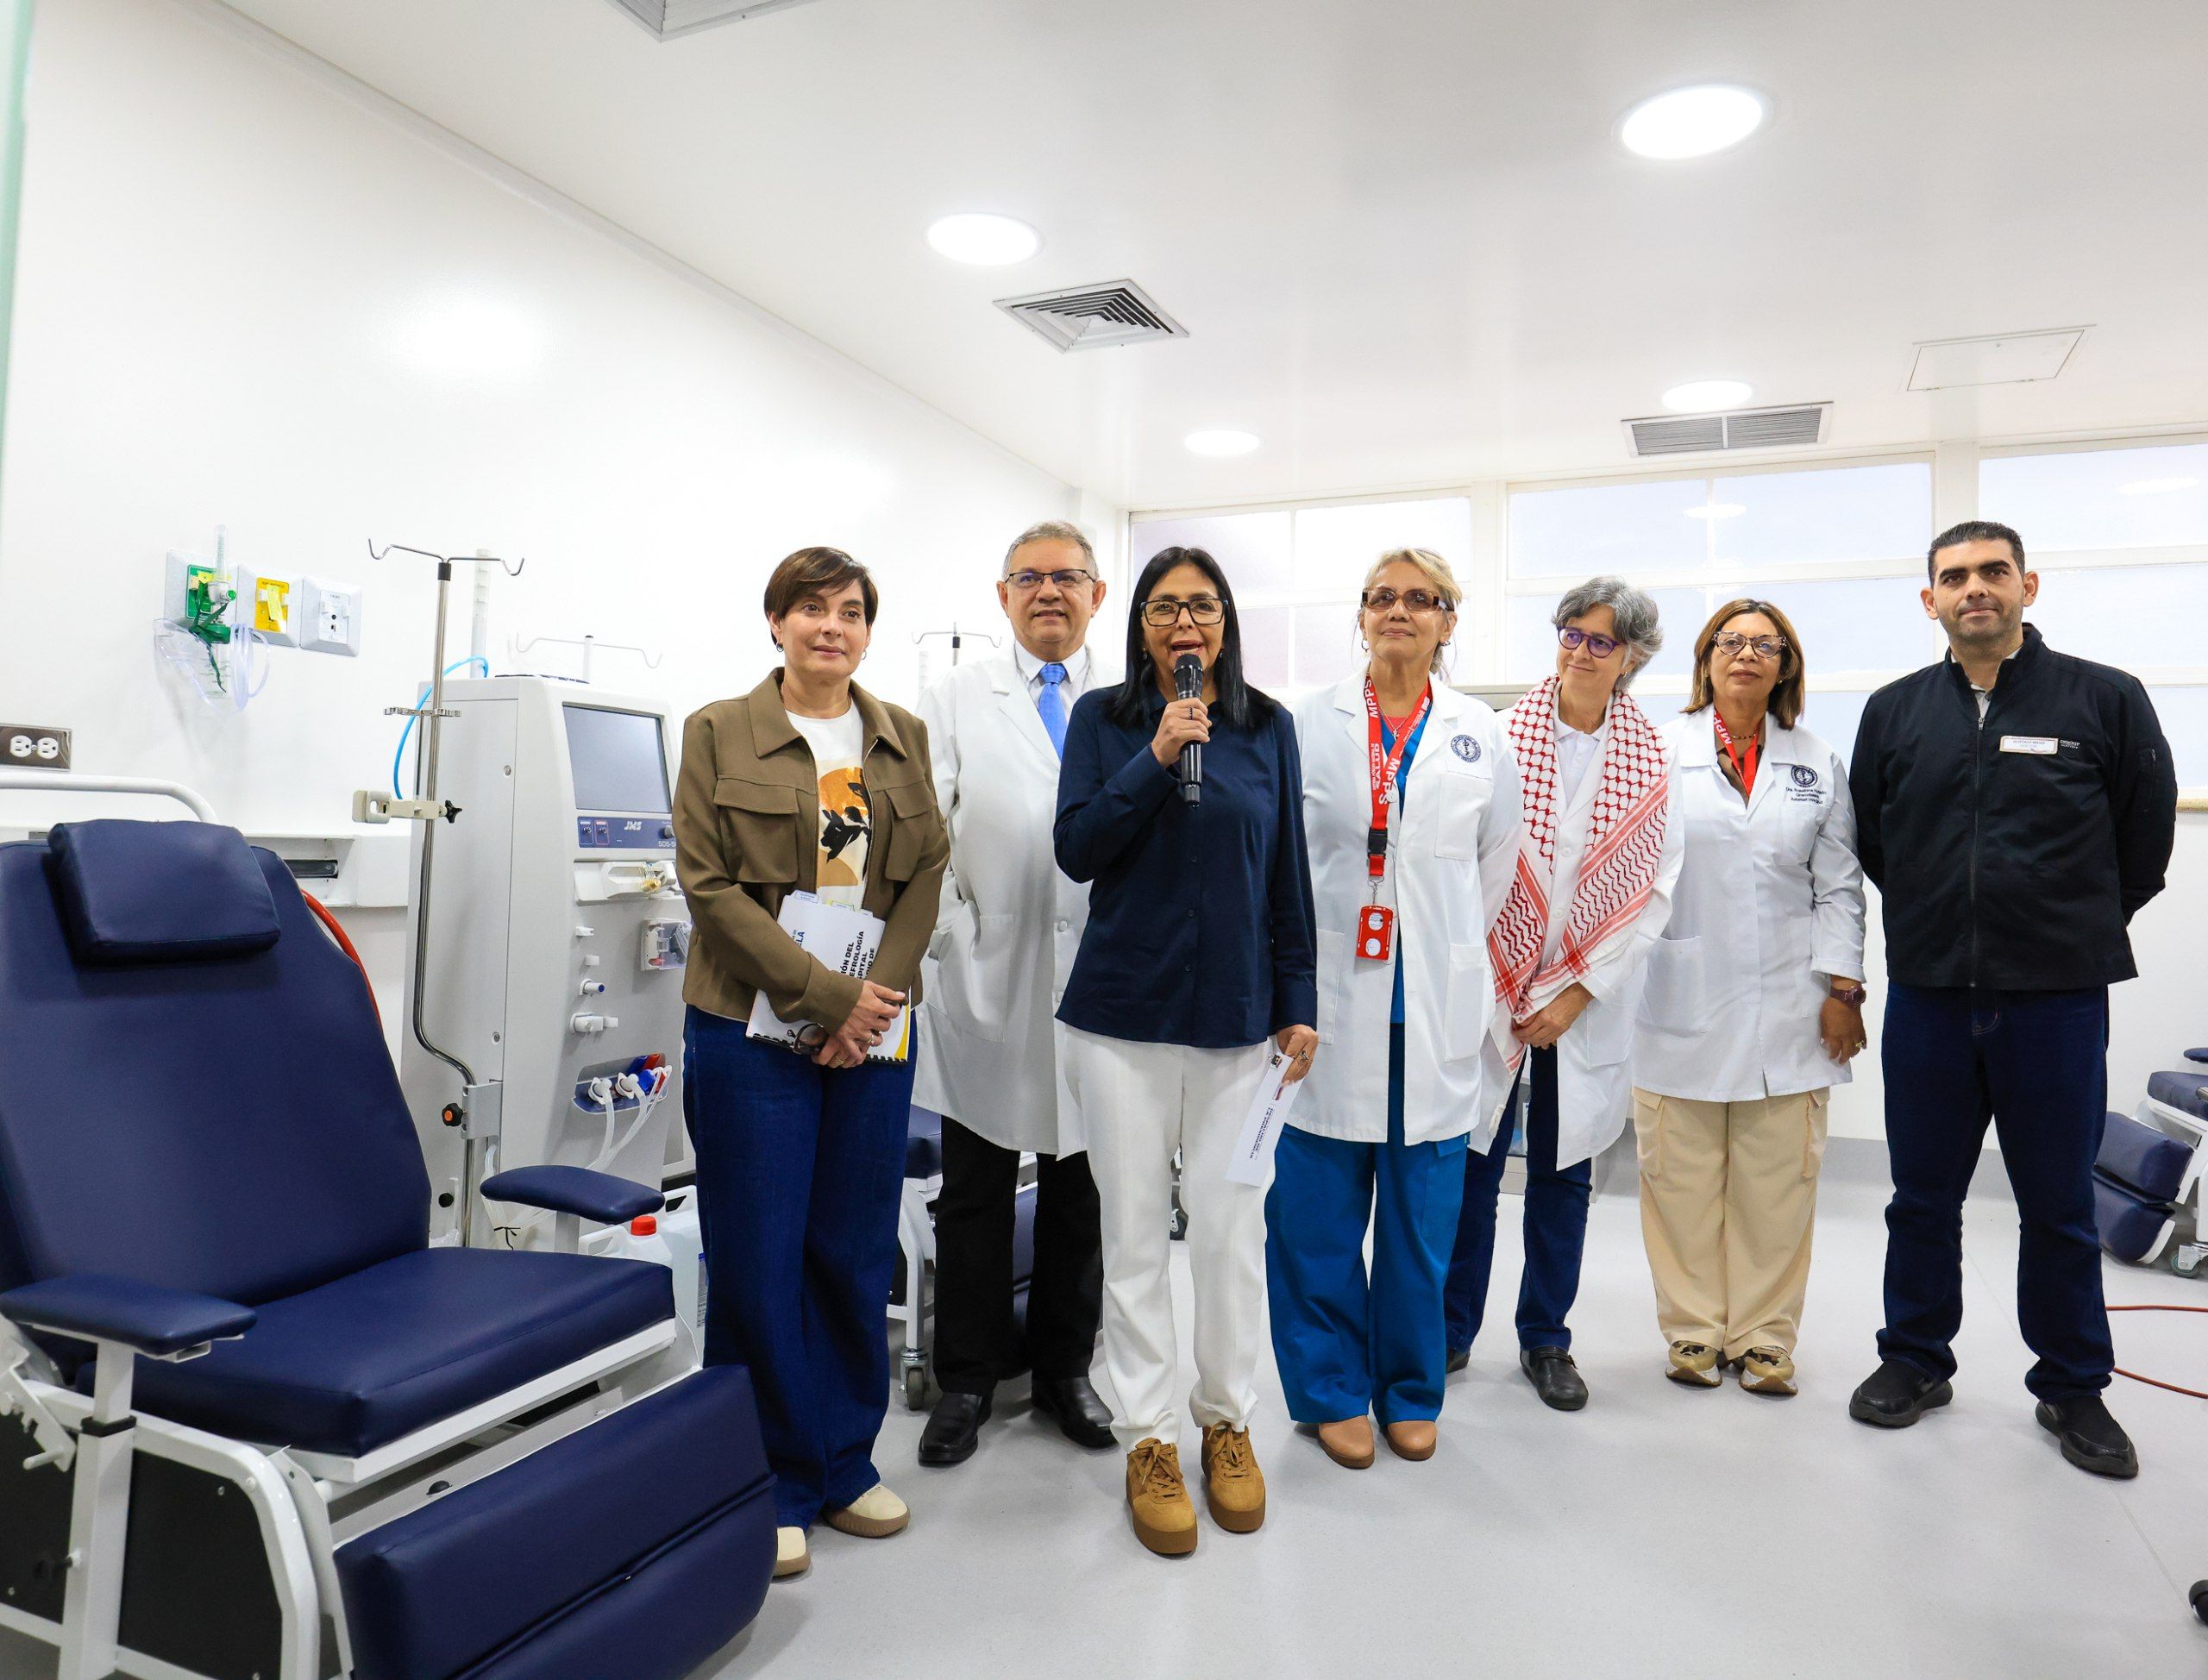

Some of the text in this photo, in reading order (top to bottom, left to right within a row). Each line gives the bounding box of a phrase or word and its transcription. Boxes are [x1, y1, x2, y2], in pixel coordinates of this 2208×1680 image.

[1364, 679, 1379, 718] MPPS
[1714, 709, 1733, 744] MPP
[1378, 757, 1402, 805] MPPS
[624, 820, 643, 831] JMS
[845, 942, 855, 959] DEL
[849, 931, 864, 977] EFROLOGÍA
[869, 948, 875, 959] DE
